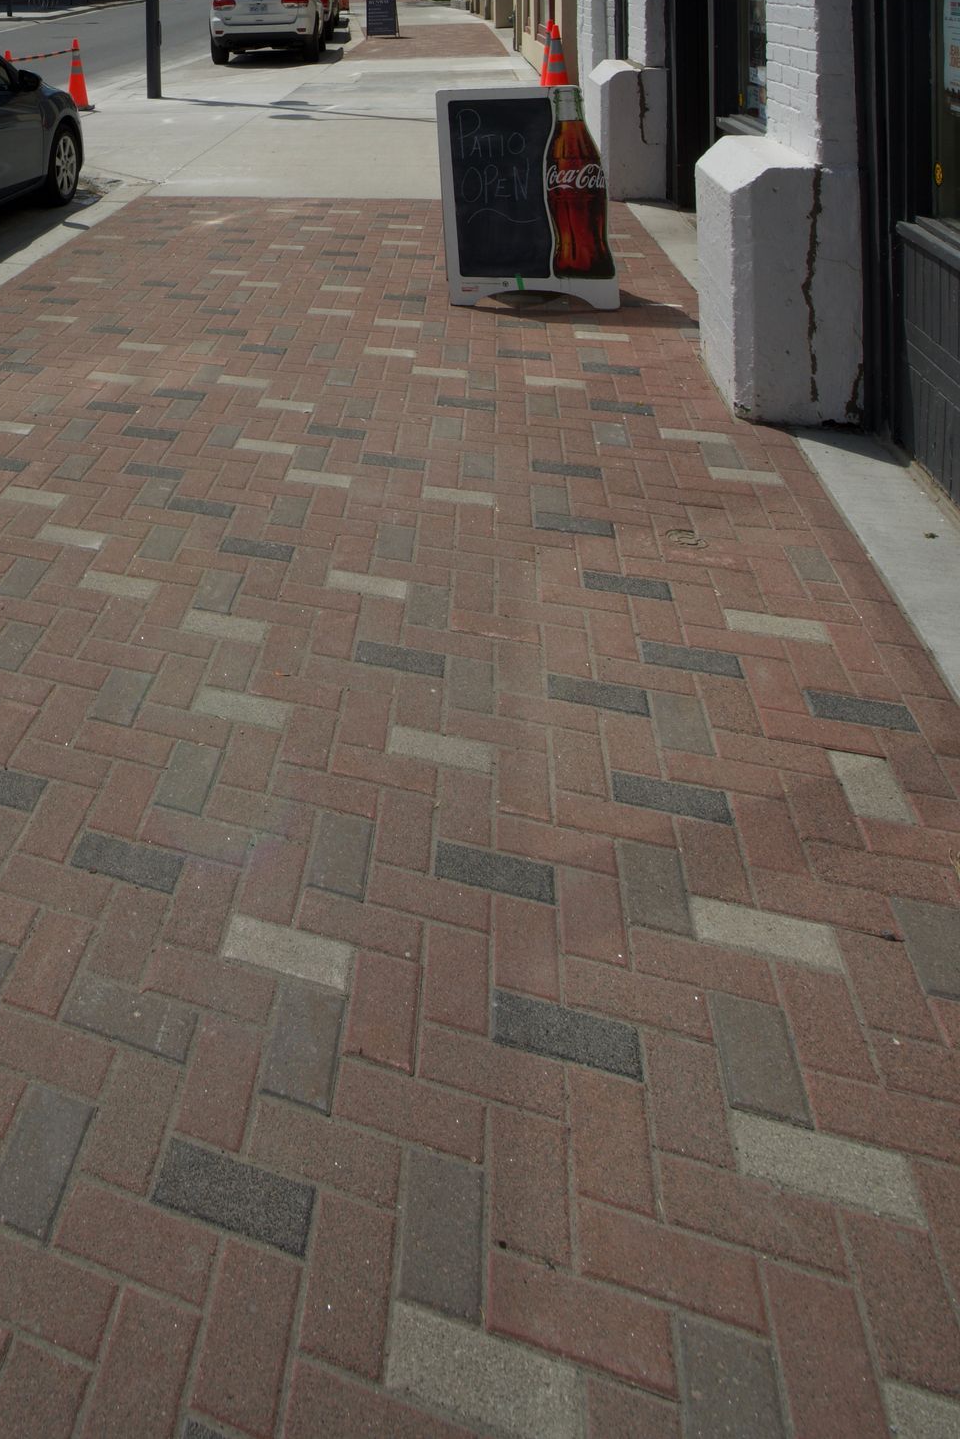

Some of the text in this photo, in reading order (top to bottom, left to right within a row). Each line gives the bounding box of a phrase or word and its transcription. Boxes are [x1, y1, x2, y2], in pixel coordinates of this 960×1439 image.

[456, 109, 526, 160] PATIO
[461, 157, 530, 205] OPEN
[546, 163, 608, 191] Coca-Cola
